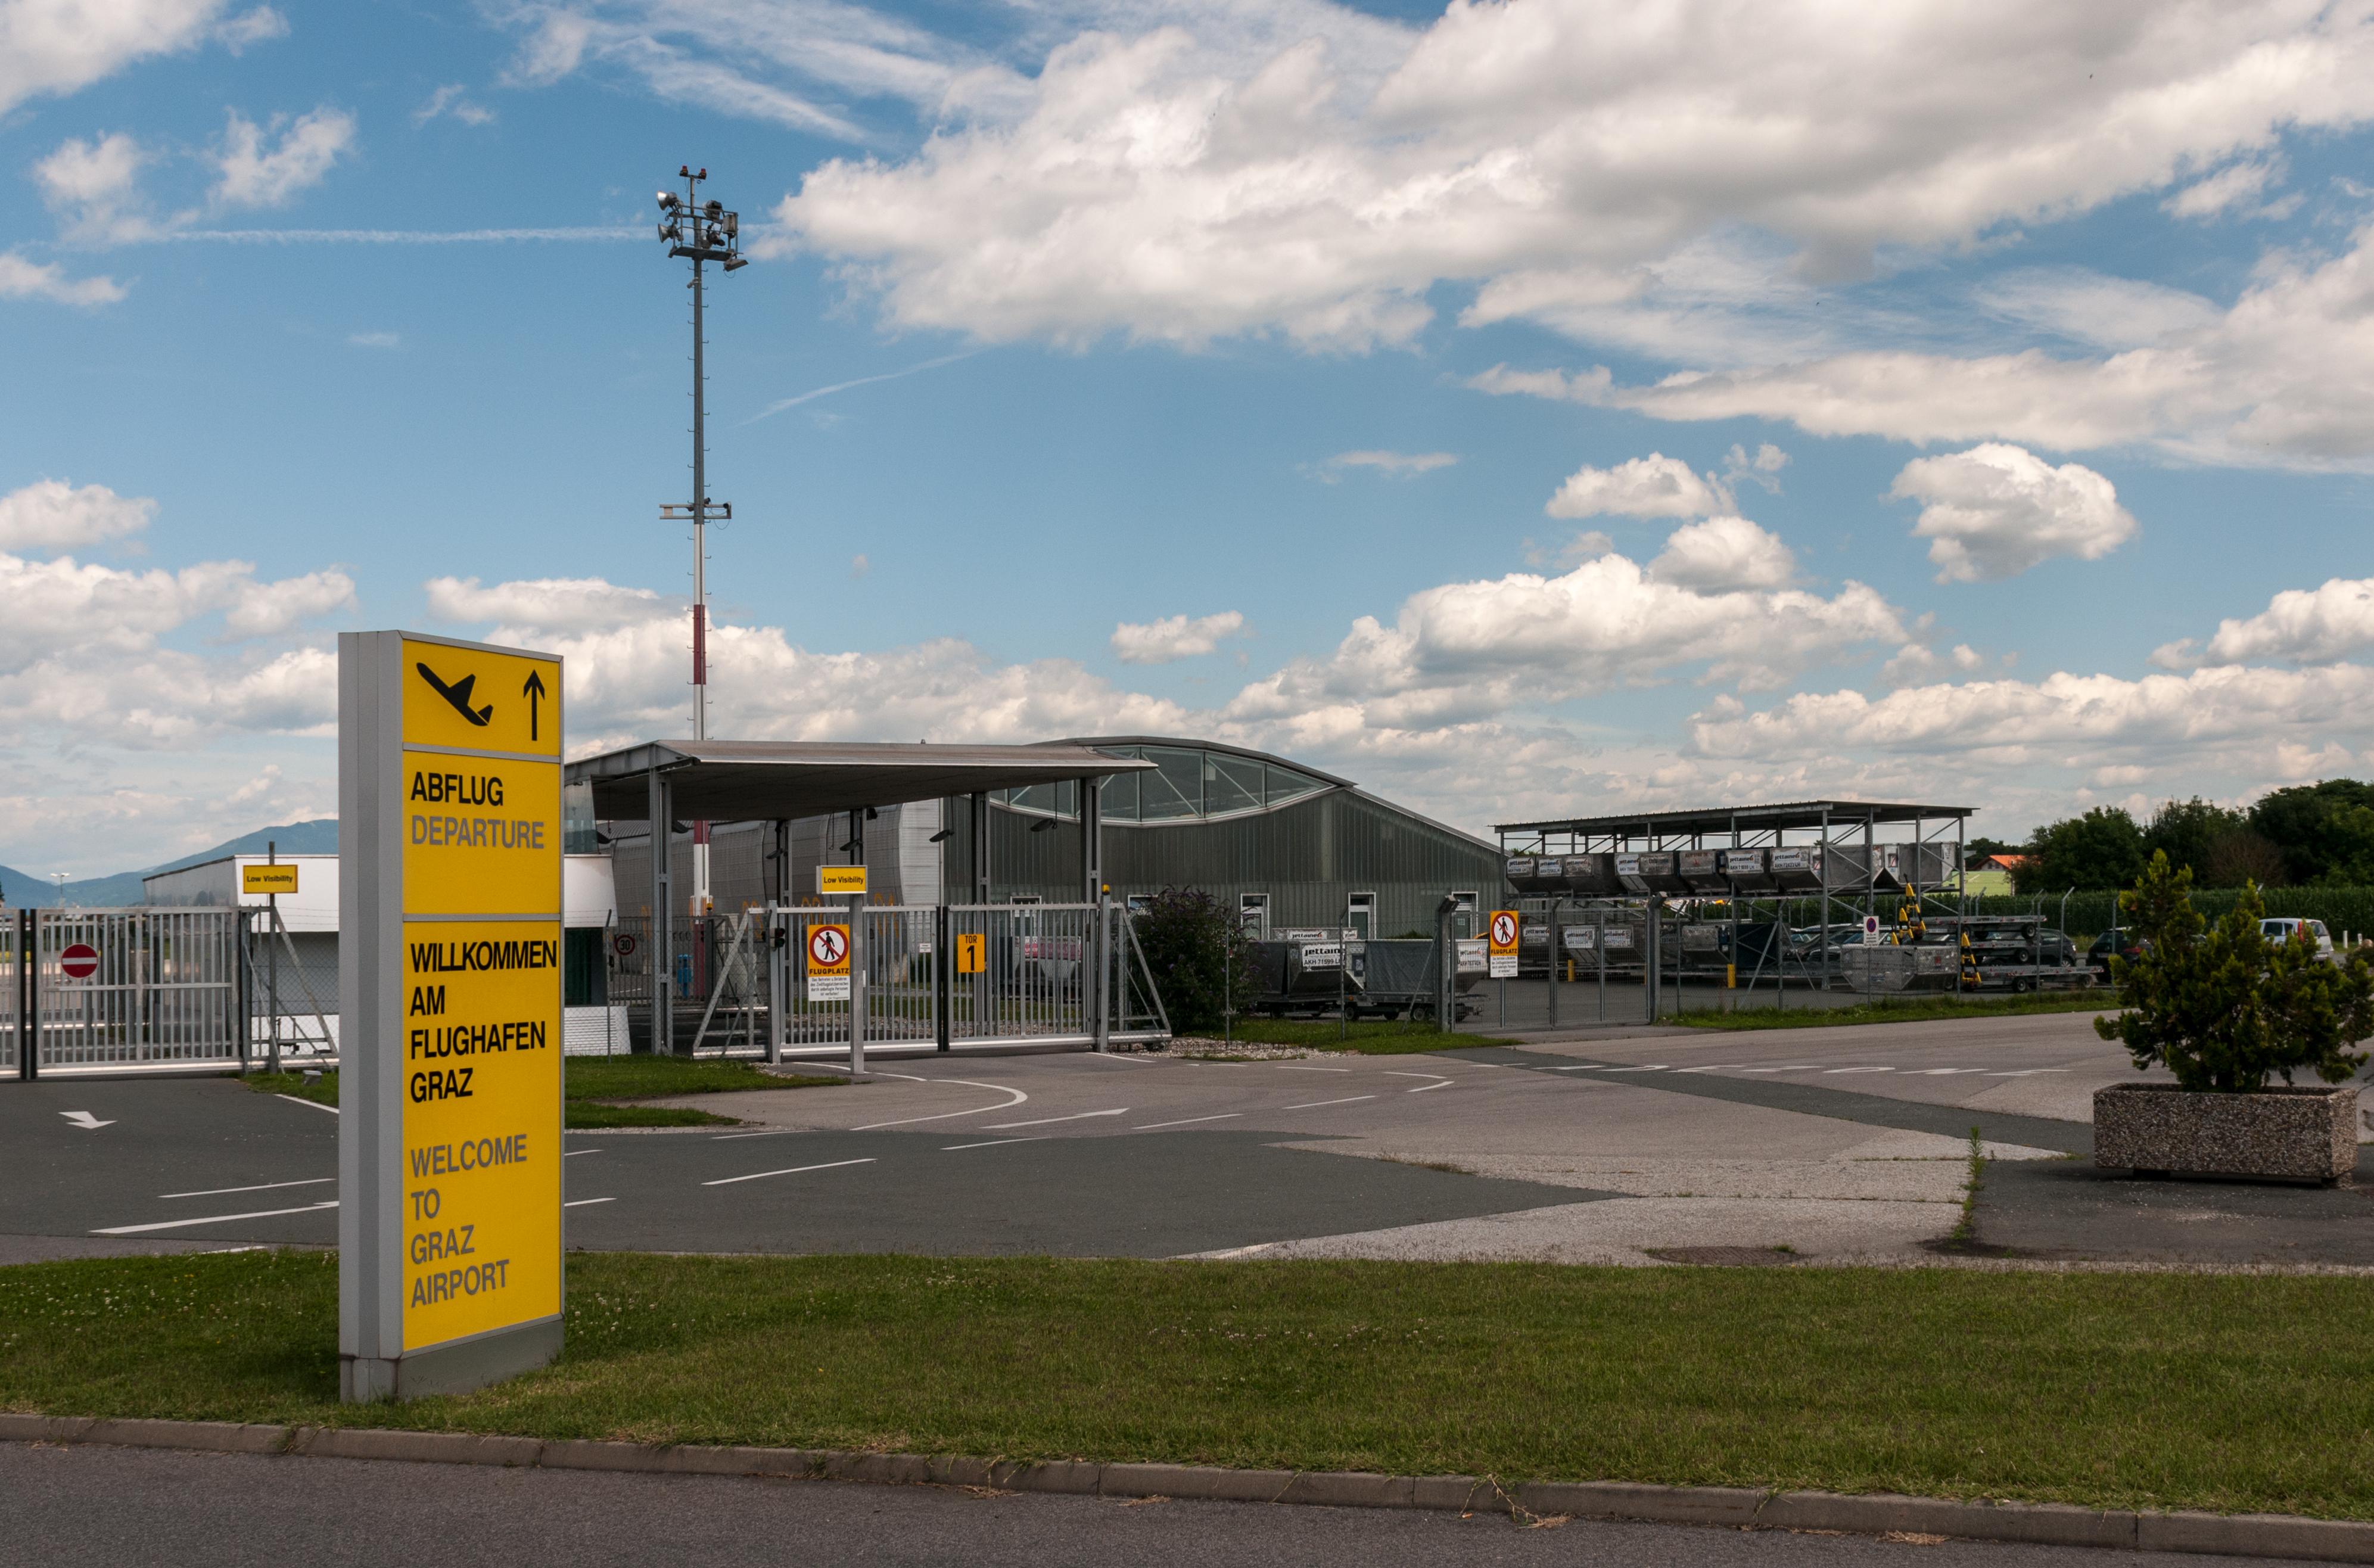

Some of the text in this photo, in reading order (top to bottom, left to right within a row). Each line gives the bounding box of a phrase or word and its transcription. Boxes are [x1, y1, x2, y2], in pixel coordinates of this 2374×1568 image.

[410, 771, 503, 806] ABFLUG
[412, 815, 545, 849] DEPARTURE
[838, 876, 864, 885] Visibility
[620, 939, 630, 950] 30
[965, 935, 977, 944] TOR
[410, 941, 557, 973] WILLKOMMEN
[967, 945, 975, 971] 1
[410, 985, 445, 1016] AM
[411, 1021, 545, 1060] FLUGHAFEN
[410, 1068, 473, 1103] GRAZ
[410, 1134, 527, 1178] WELCOME
[410, 1189, 441, 1221] TO
[410, 1225, 475, 1264] GRAZ
[411, 1259, 509, 1308] AIRPORT
